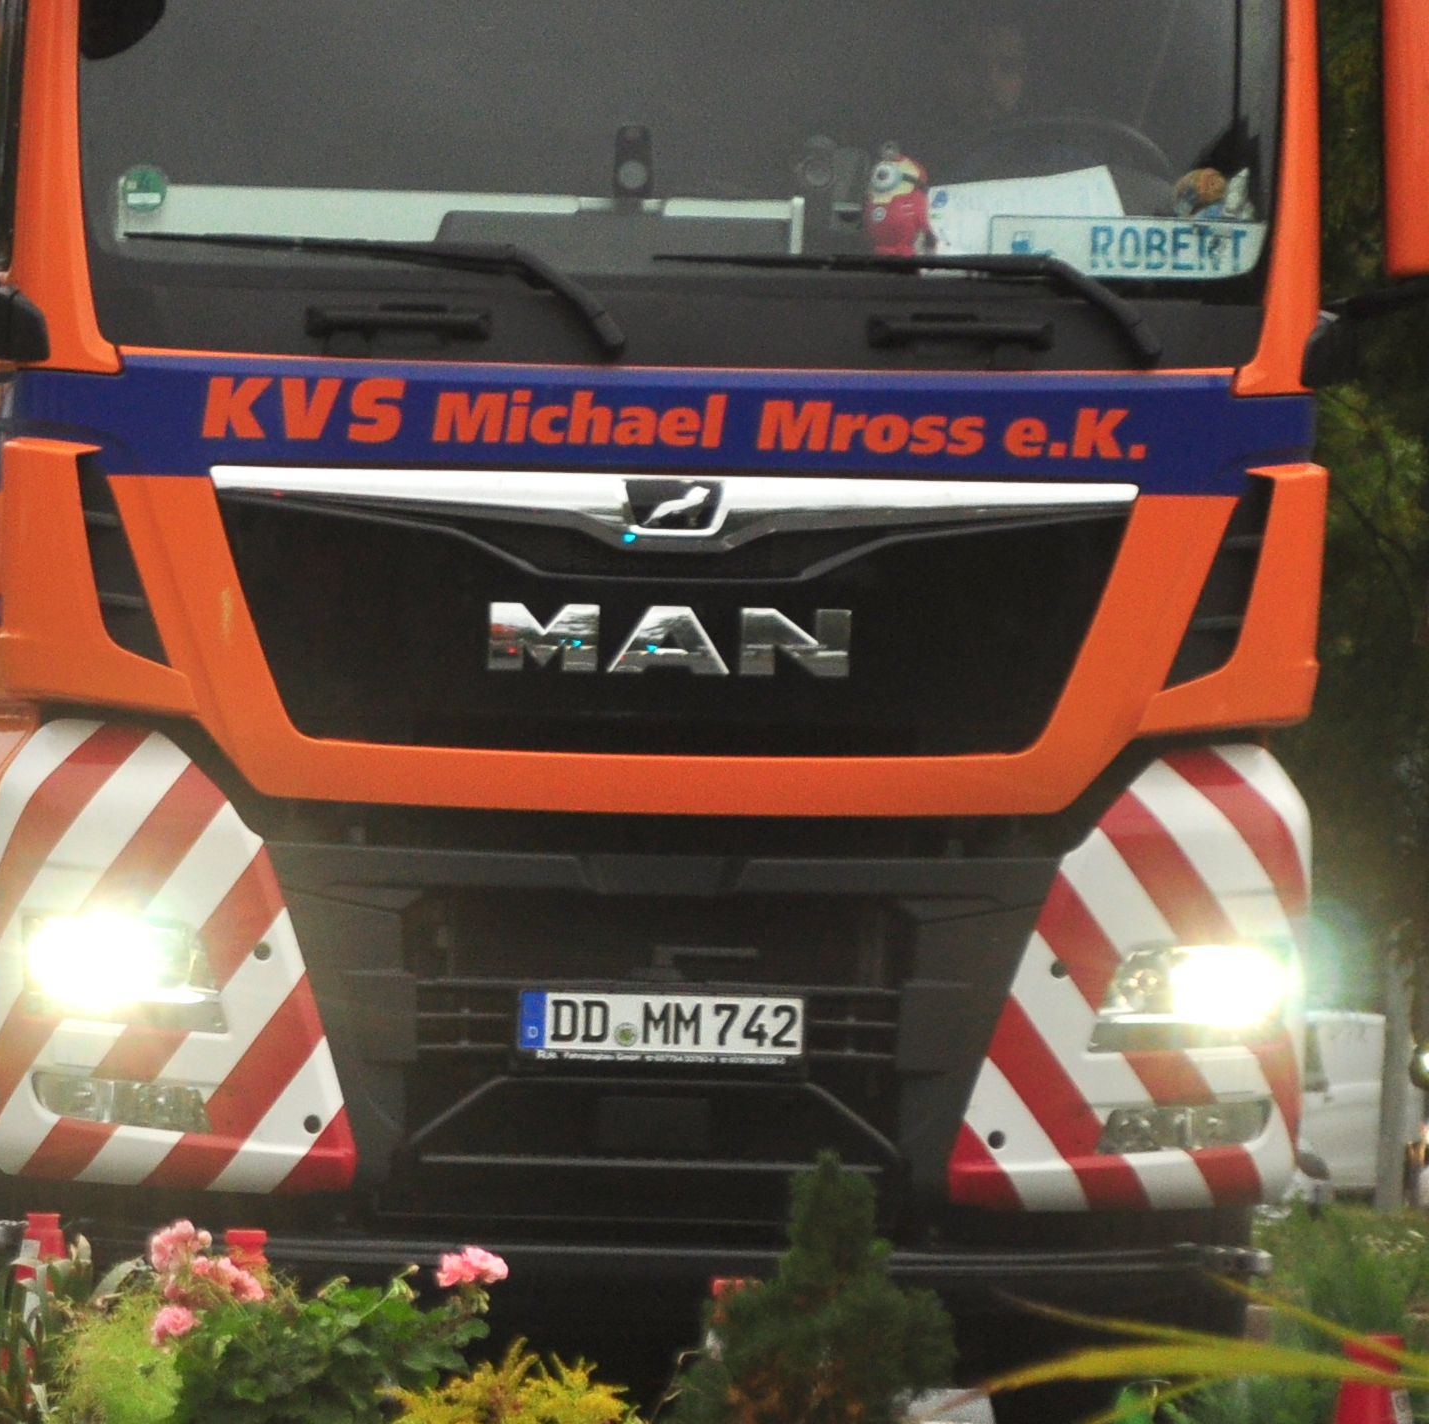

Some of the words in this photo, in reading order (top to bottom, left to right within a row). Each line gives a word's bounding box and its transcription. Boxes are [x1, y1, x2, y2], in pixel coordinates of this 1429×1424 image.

[1090, 225, 1248, 272] ROBERT
[201, 376, 406, 443] KVS
[431, 389, 728, 449] Michael
[756, 399, 986, 456] Mross
[1002, 407, 1148, 460] e.K.
[487, 601, 853, 678] MAN
[527, 1026, 539, 1039] D
[551, 999, 610, 1043] DD
[642, 1000, 703, 1047] MM
[714, 1003, 799, 1049] 742
